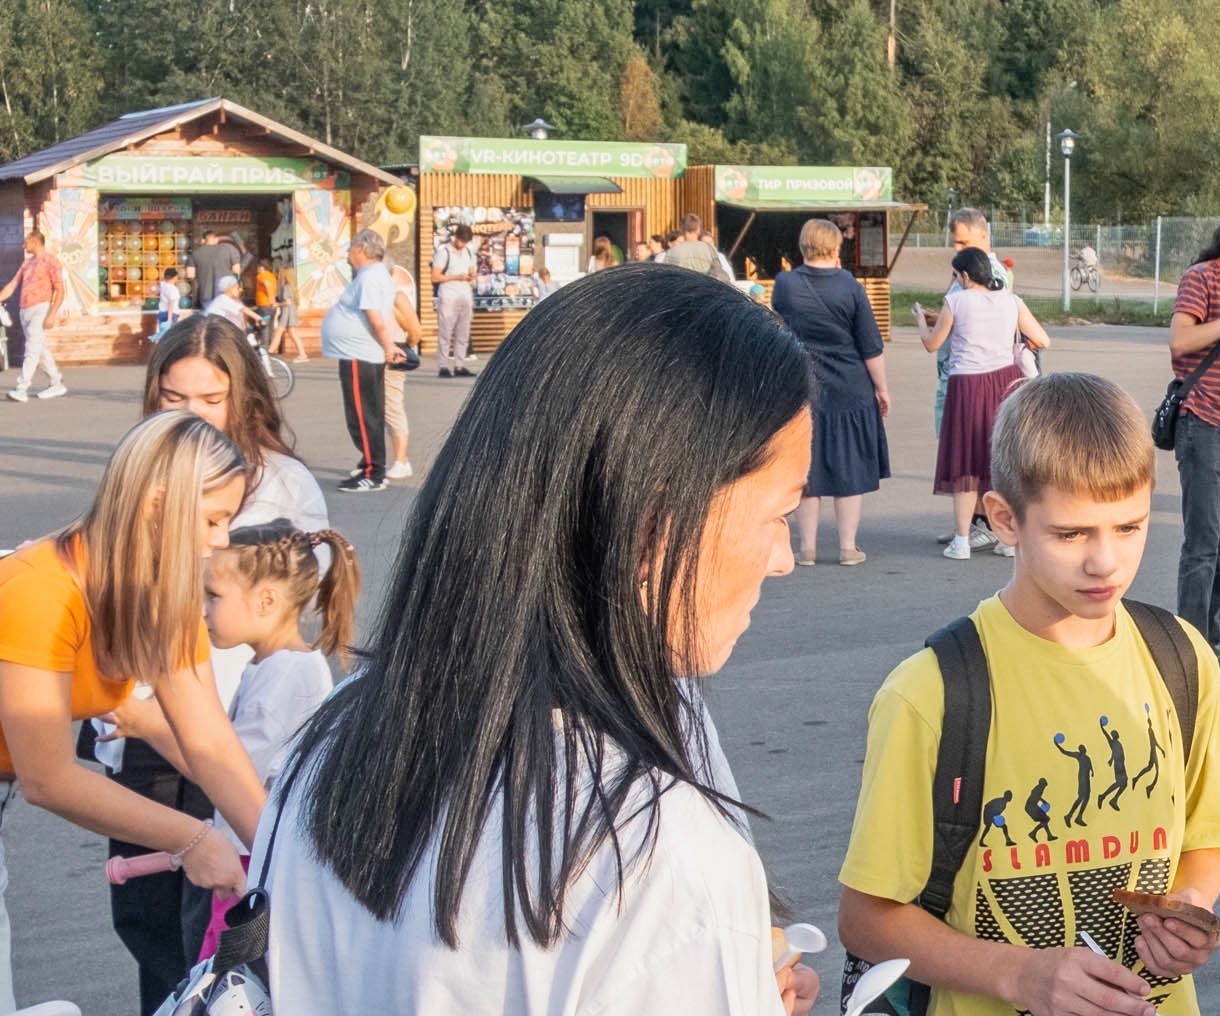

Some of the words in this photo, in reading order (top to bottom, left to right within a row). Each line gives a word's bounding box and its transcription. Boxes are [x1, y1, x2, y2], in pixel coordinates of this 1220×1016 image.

[470, 149, 612, 167] VR-КИНОТЕАТР
[620, 152, 643, 168] 9D
[231, 166, 295, 184] ПРИЗ
[758, 178, 782, 190] ТИР
